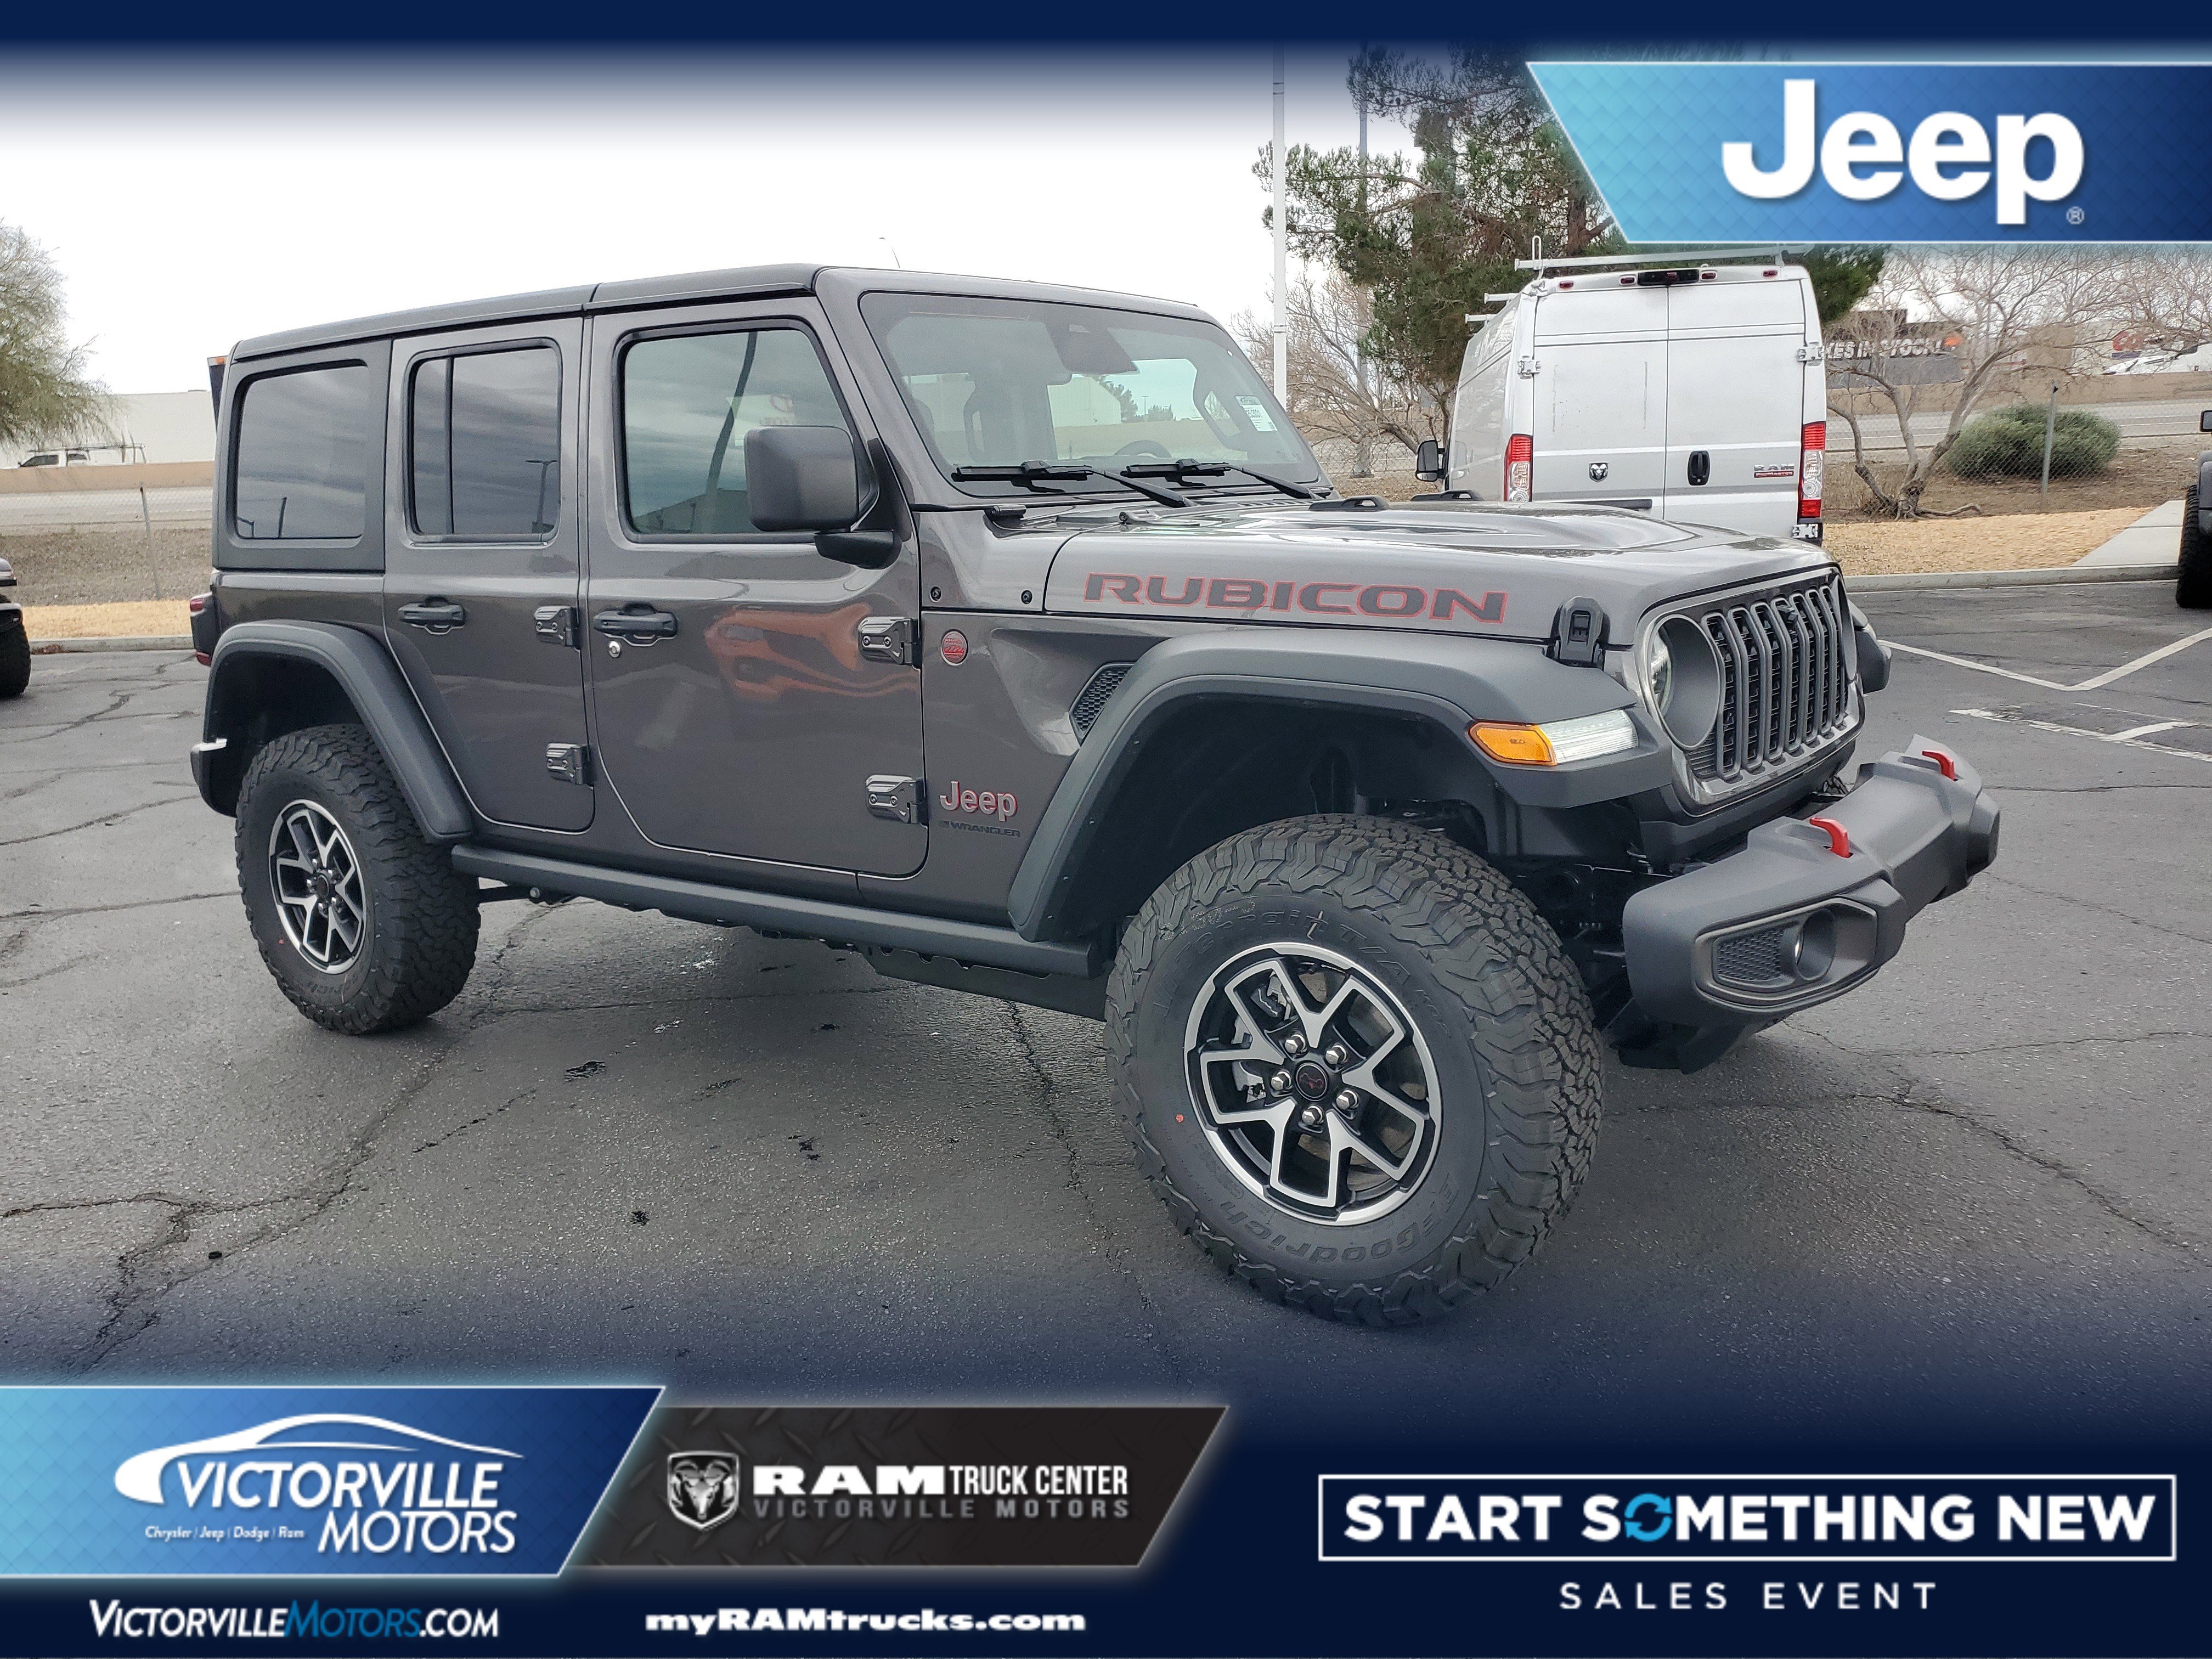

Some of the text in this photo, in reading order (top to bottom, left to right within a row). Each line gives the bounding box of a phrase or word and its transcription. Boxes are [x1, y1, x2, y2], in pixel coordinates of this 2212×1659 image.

[1084, 573, 1508, 624] RUBICON
[939, 780, 1018, 822] Jeep
[950, 821, 1021, 838] WRANGLER
